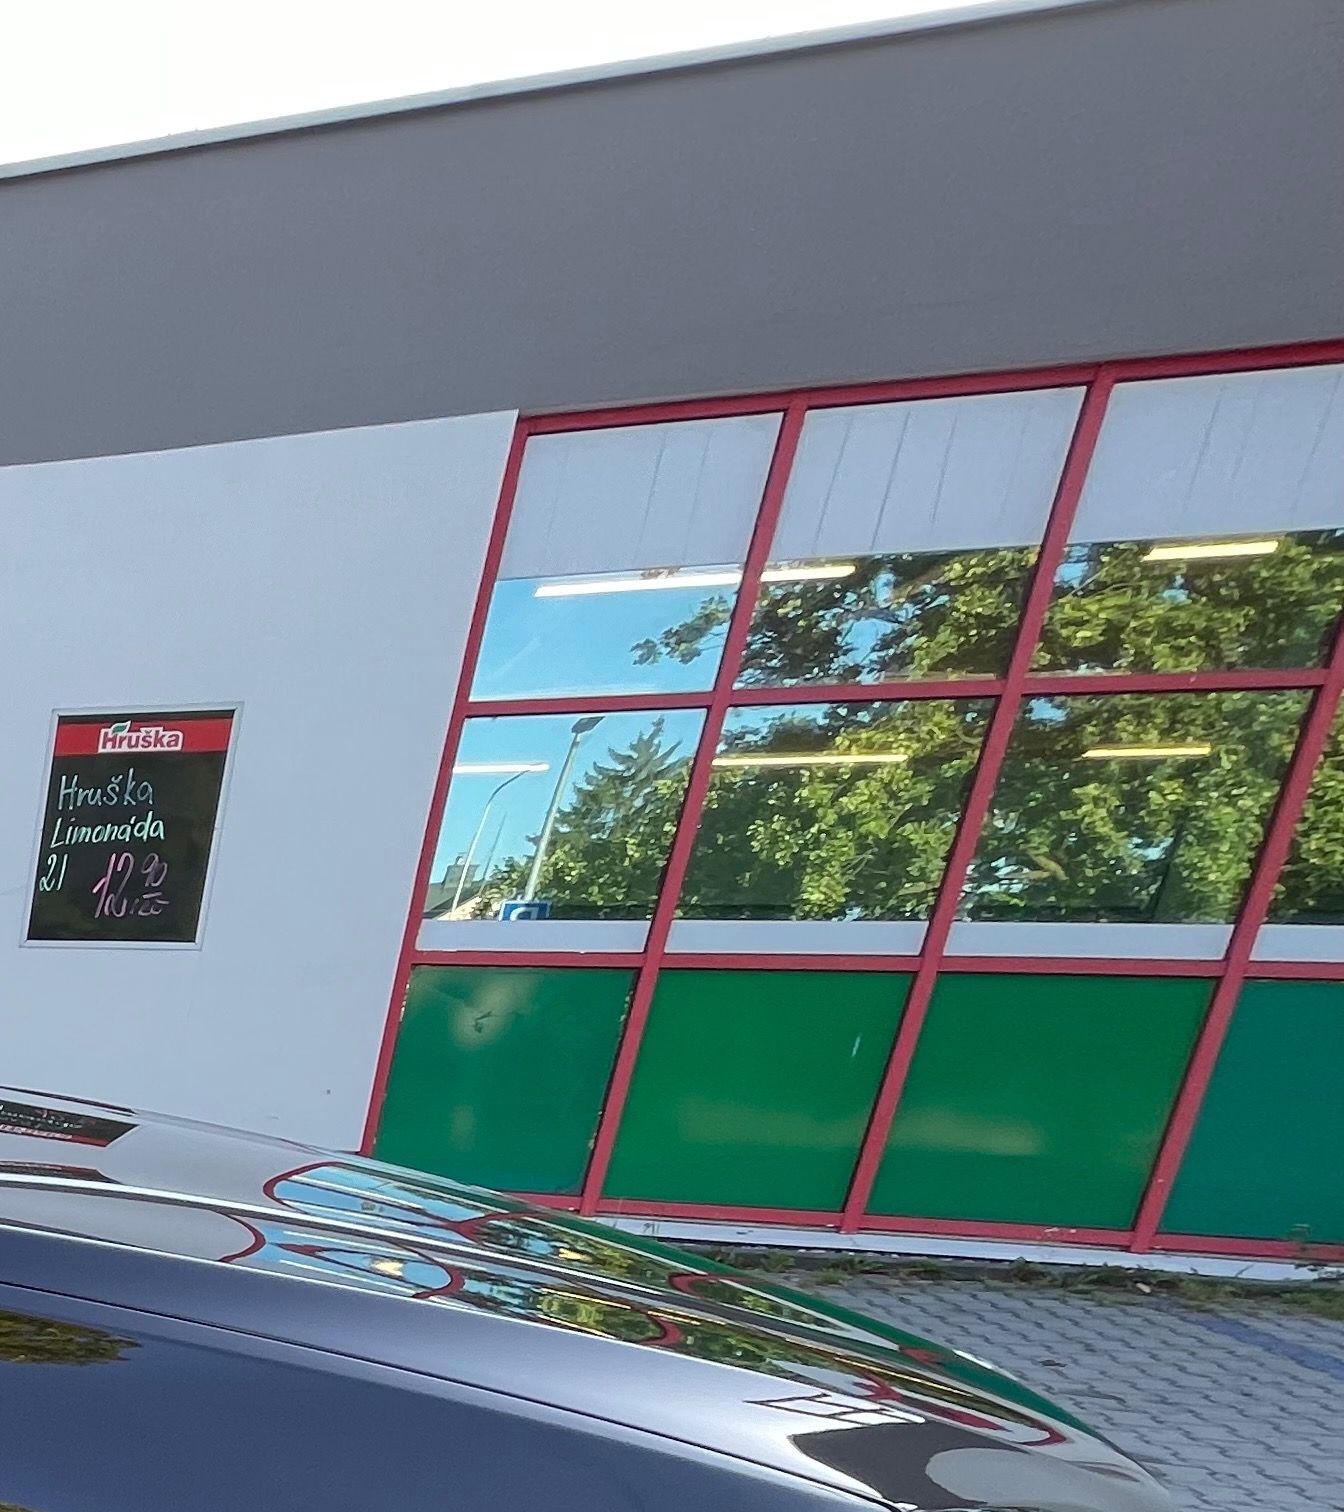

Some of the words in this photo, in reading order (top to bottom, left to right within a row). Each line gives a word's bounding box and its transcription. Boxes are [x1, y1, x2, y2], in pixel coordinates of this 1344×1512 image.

[101, 727, 181, 750] Hruška
[58, 768, 153, 810] Hruška
[50, 811, 165, 848] Limonáda
